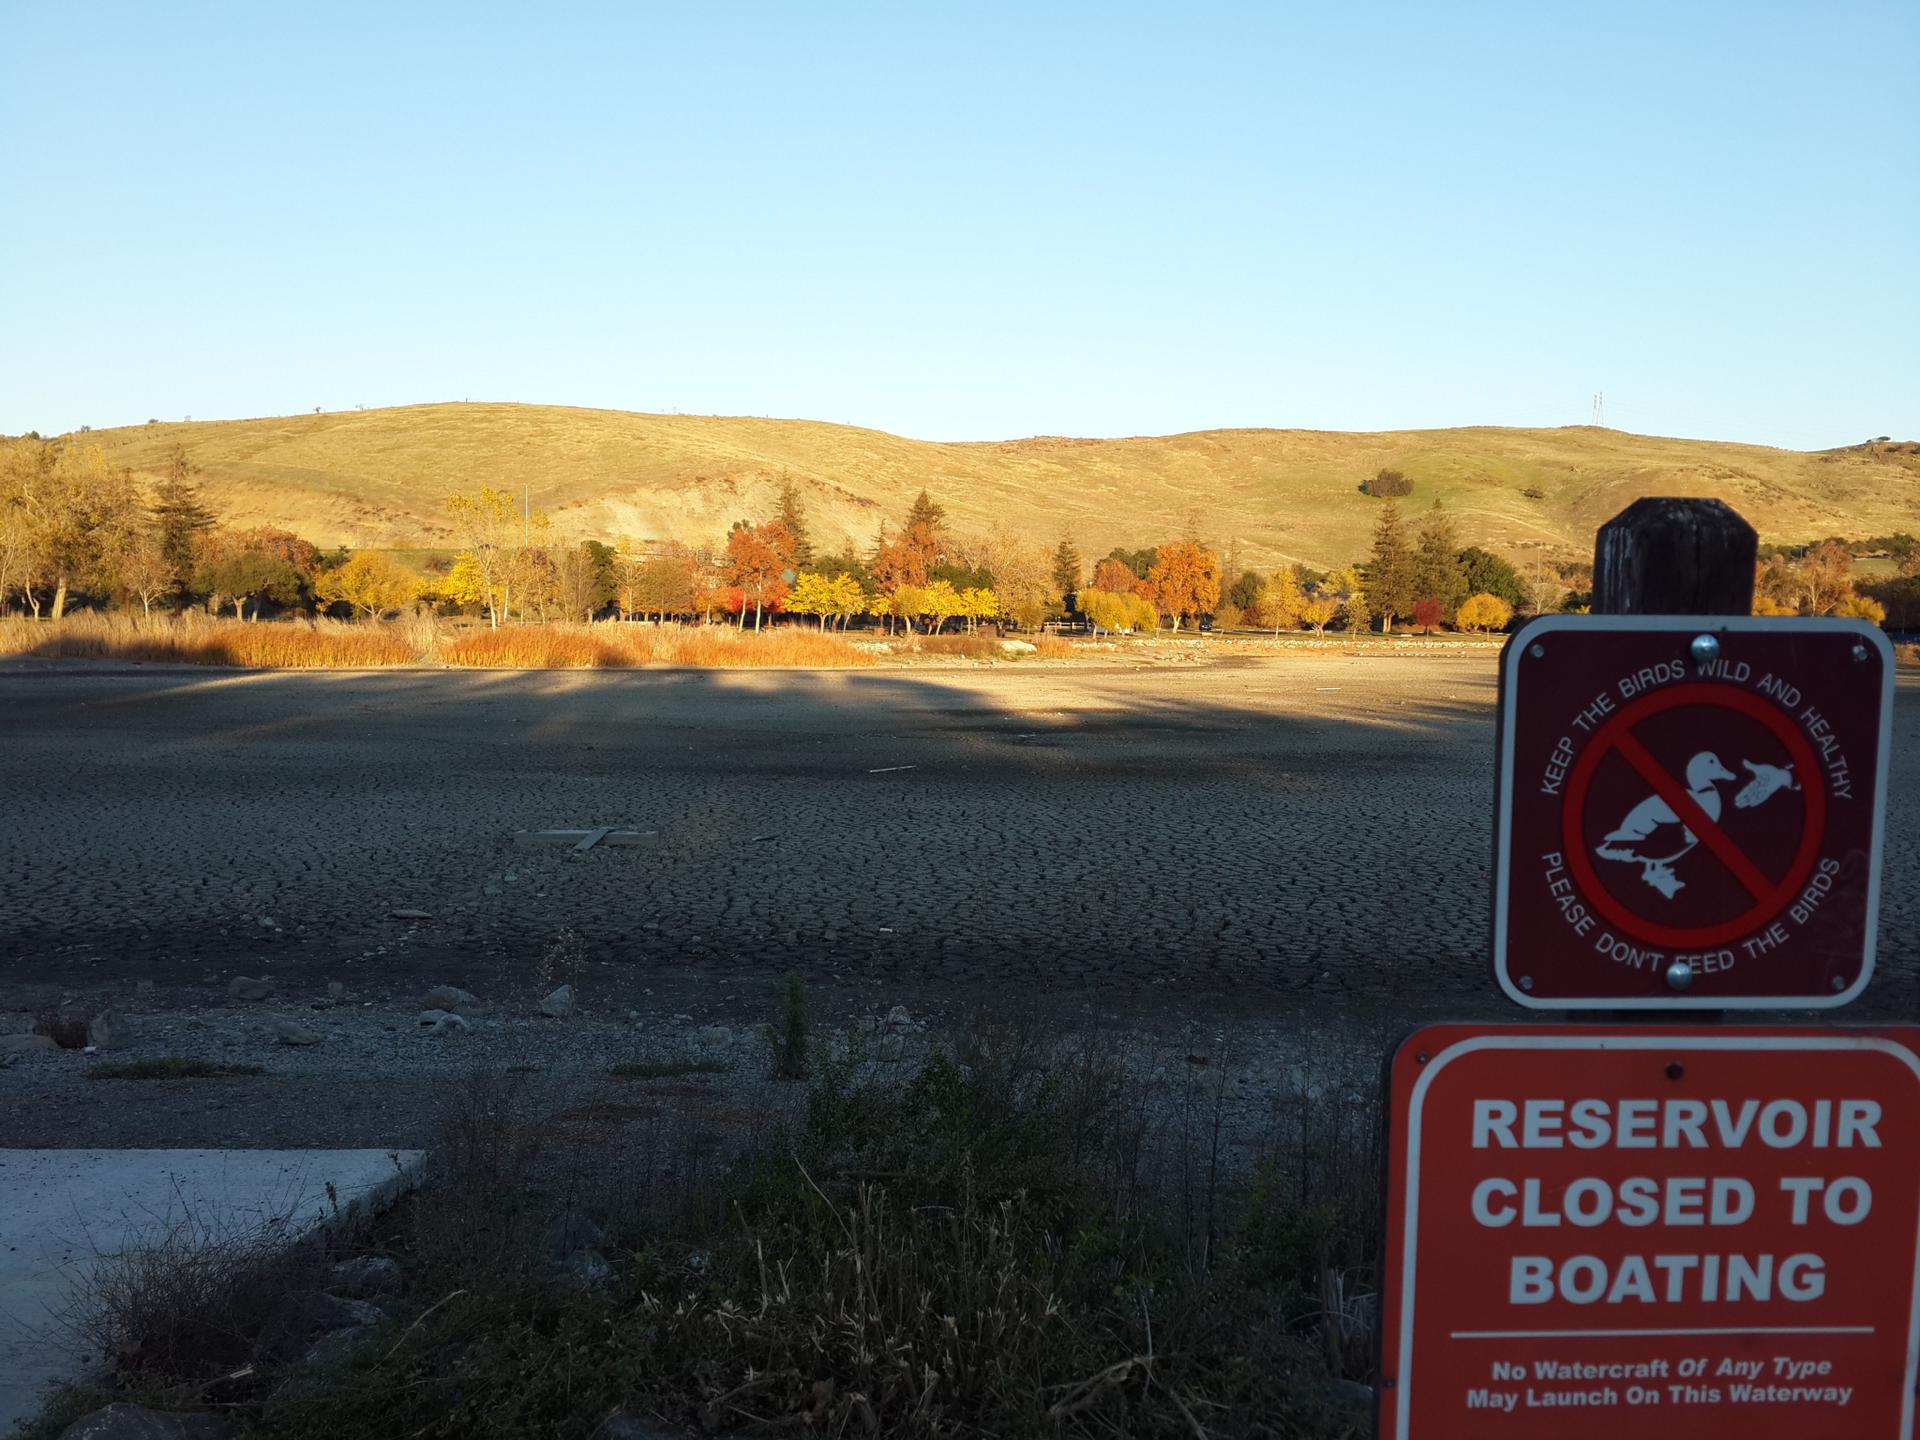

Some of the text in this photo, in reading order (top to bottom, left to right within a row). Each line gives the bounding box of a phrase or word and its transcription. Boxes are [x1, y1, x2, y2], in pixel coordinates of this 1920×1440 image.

[1541, 660, 1852, 798] KEEP THE BIRDS WILD AND HEALTHY
[1542, 852, 1595, 936] PLEASE
[1595, 933, 1664, 971] DON'T
[1743, 923, 1789, 958] THE
[1790, 859, 1839, 924] BIRDS
[1472, 1099, 1881, 1148] RESERVOIR
[1472, 1177, 1872, 1227] CLOSED TO
[1510, 1254, 1825, 1304] BOATING
[1493, 1357, 1832, 1380] No Watercraft Of Any Type
[1467, 1384, 1852, 1412] May Launch On This Waterway
